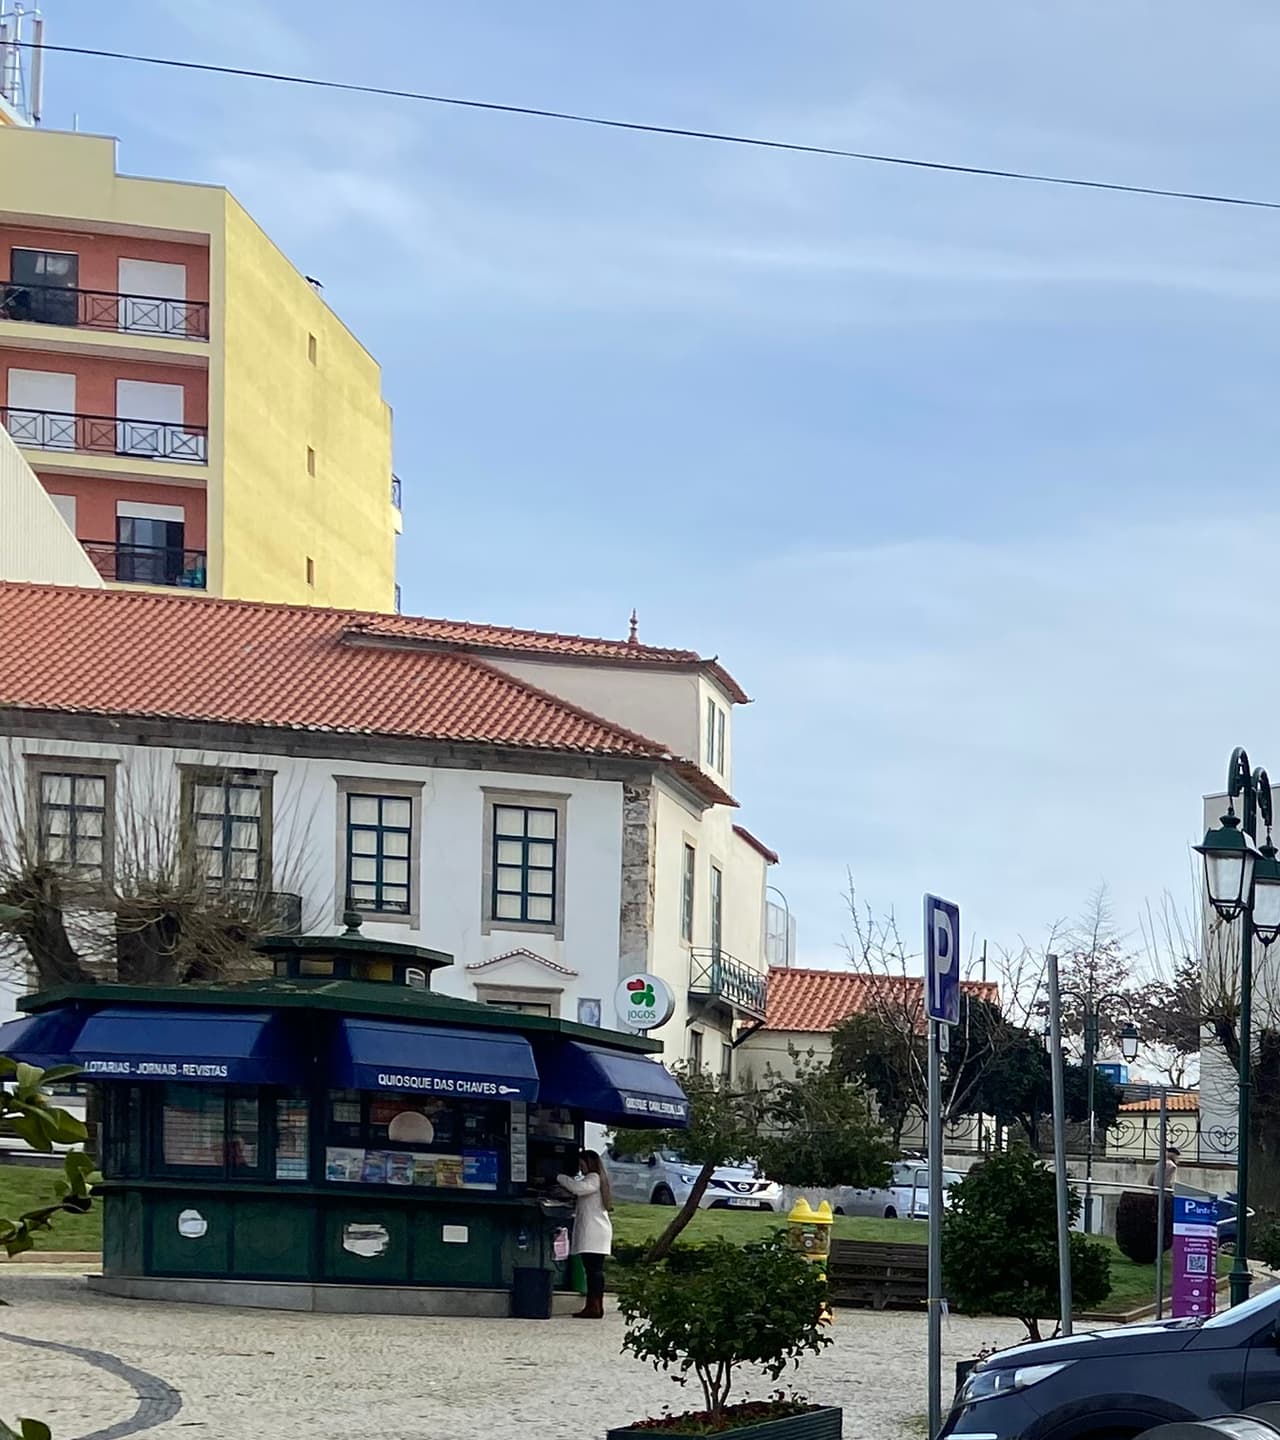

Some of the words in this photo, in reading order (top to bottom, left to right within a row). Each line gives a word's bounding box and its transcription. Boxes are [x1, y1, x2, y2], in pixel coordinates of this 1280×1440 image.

[933, 908, 954, 1009] P
[627, 1010, 656, 1021] JOGOS
[83, 1061, 130, 1074] LOTARIAS
[136, 1063, 177, 1075] JORNAIS
[183, 1064, 228, 1077] REVISTAS
[378, 1074, 431, 1089] QUIOSQUE
[434, 1078, 454, 1091] DAS
[456, 1080, 496, 1095] CHAVES
